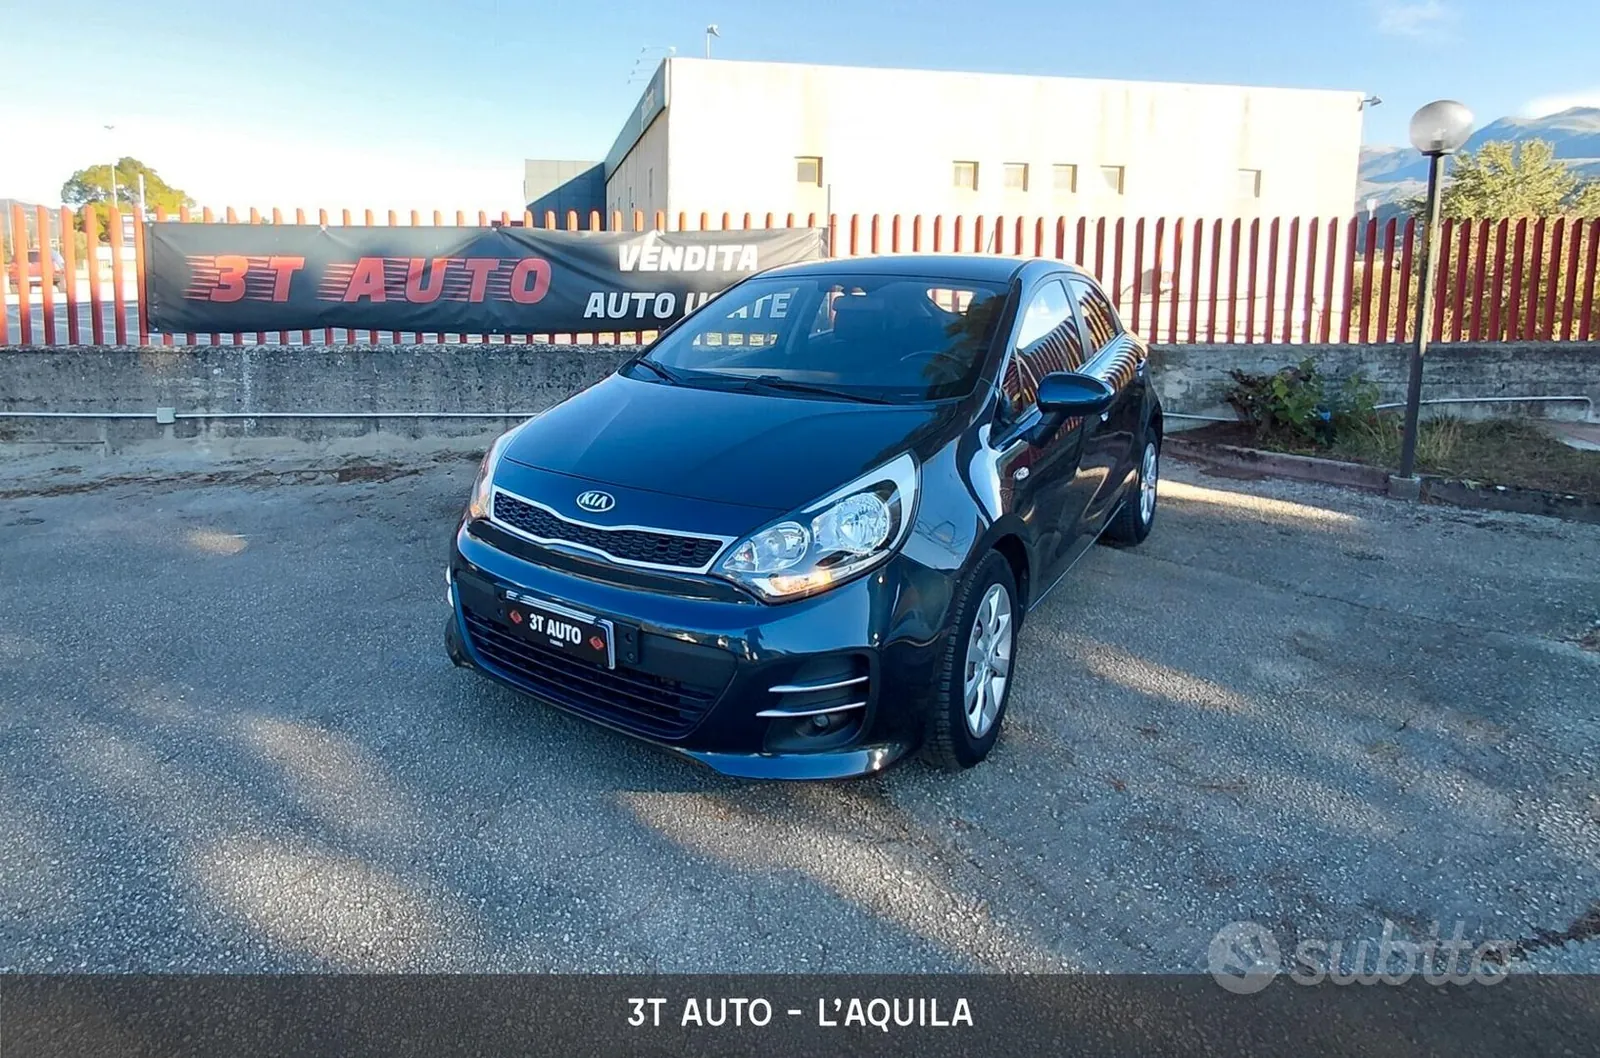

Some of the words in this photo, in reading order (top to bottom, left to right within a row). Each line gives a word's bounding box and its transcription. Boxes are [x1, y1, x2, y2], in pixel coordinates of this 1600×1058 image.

[618, 244, 758, 272] VENDITA
[207, 255, 305, 303] 3T
[340, 257, 552, 304] AUTO
[584, 292, 676, 319] AUTO
[685, 292, 791, 319] UTE
[580, 492, 608, 509] KIA
[529, 613, 545, 632] 3T
[546, 618, 582, 645] AUTO
